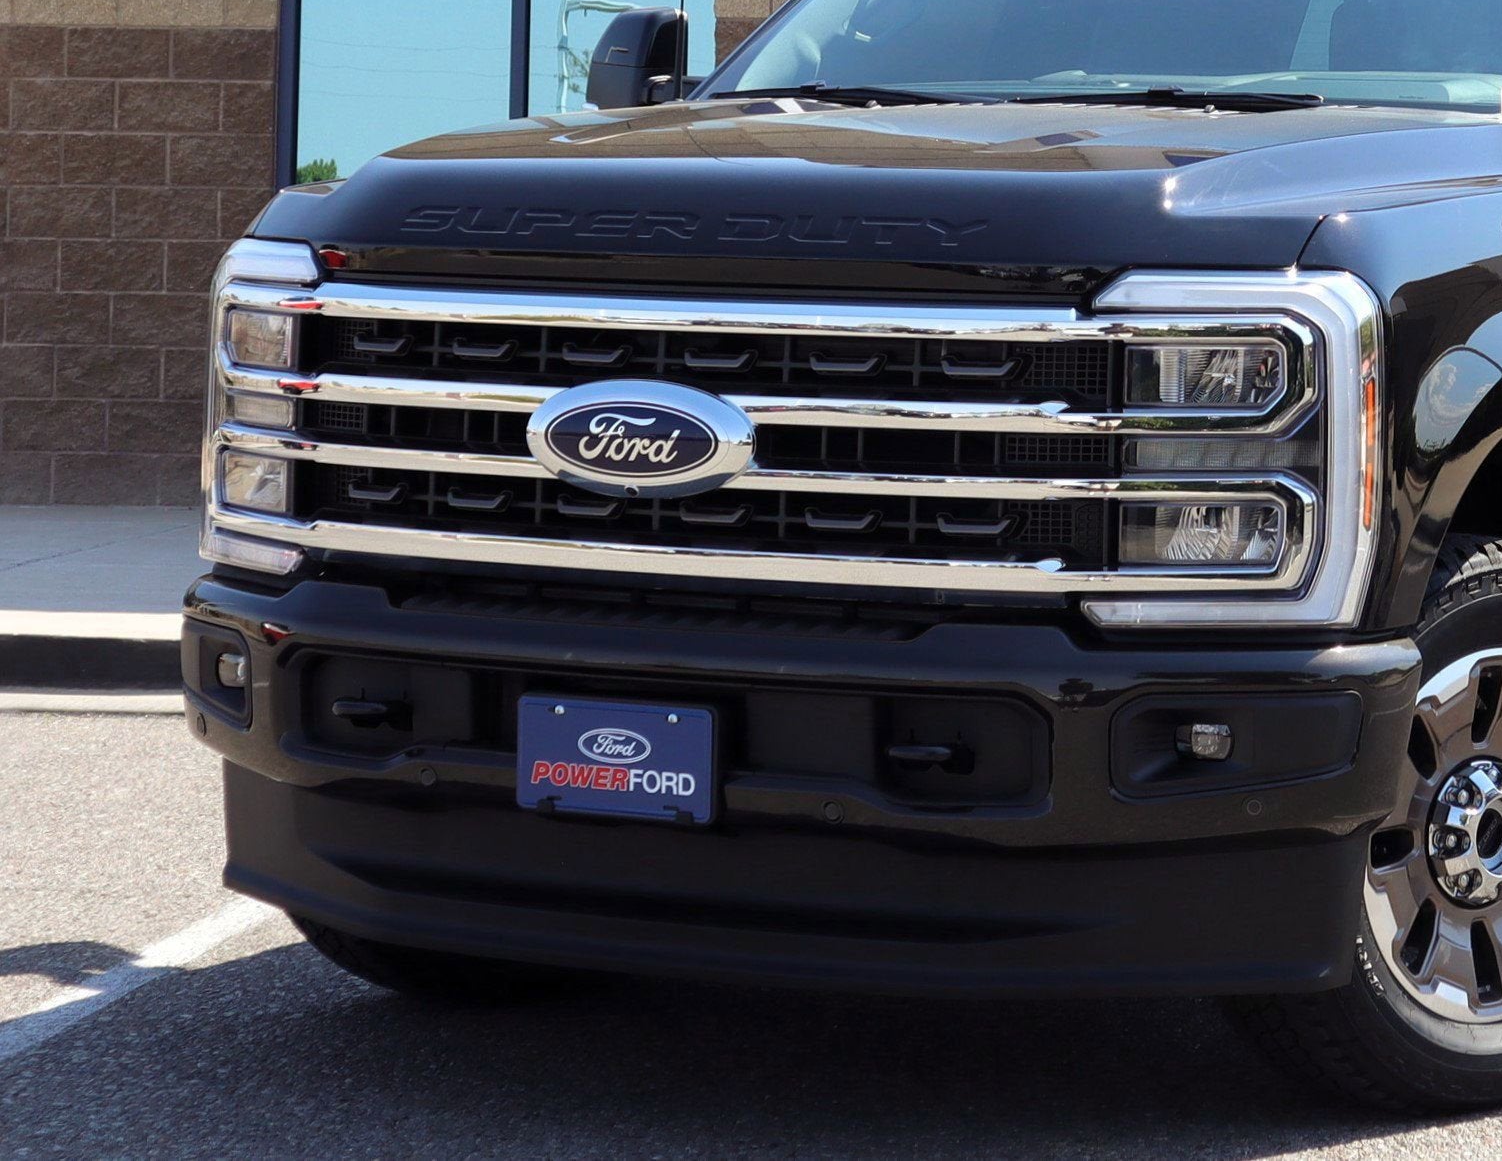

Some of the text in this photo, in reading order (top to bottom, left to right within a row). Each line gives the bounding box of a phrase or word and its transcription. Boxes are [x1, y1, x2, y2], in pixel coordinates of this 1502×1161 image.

[399, 205, 989, 247] SUPER DUTY
[578, 412, 681, 464] Ford
[592, 733, 637, 757] Ford
[530, 760, 696, 797] POWERFORD
